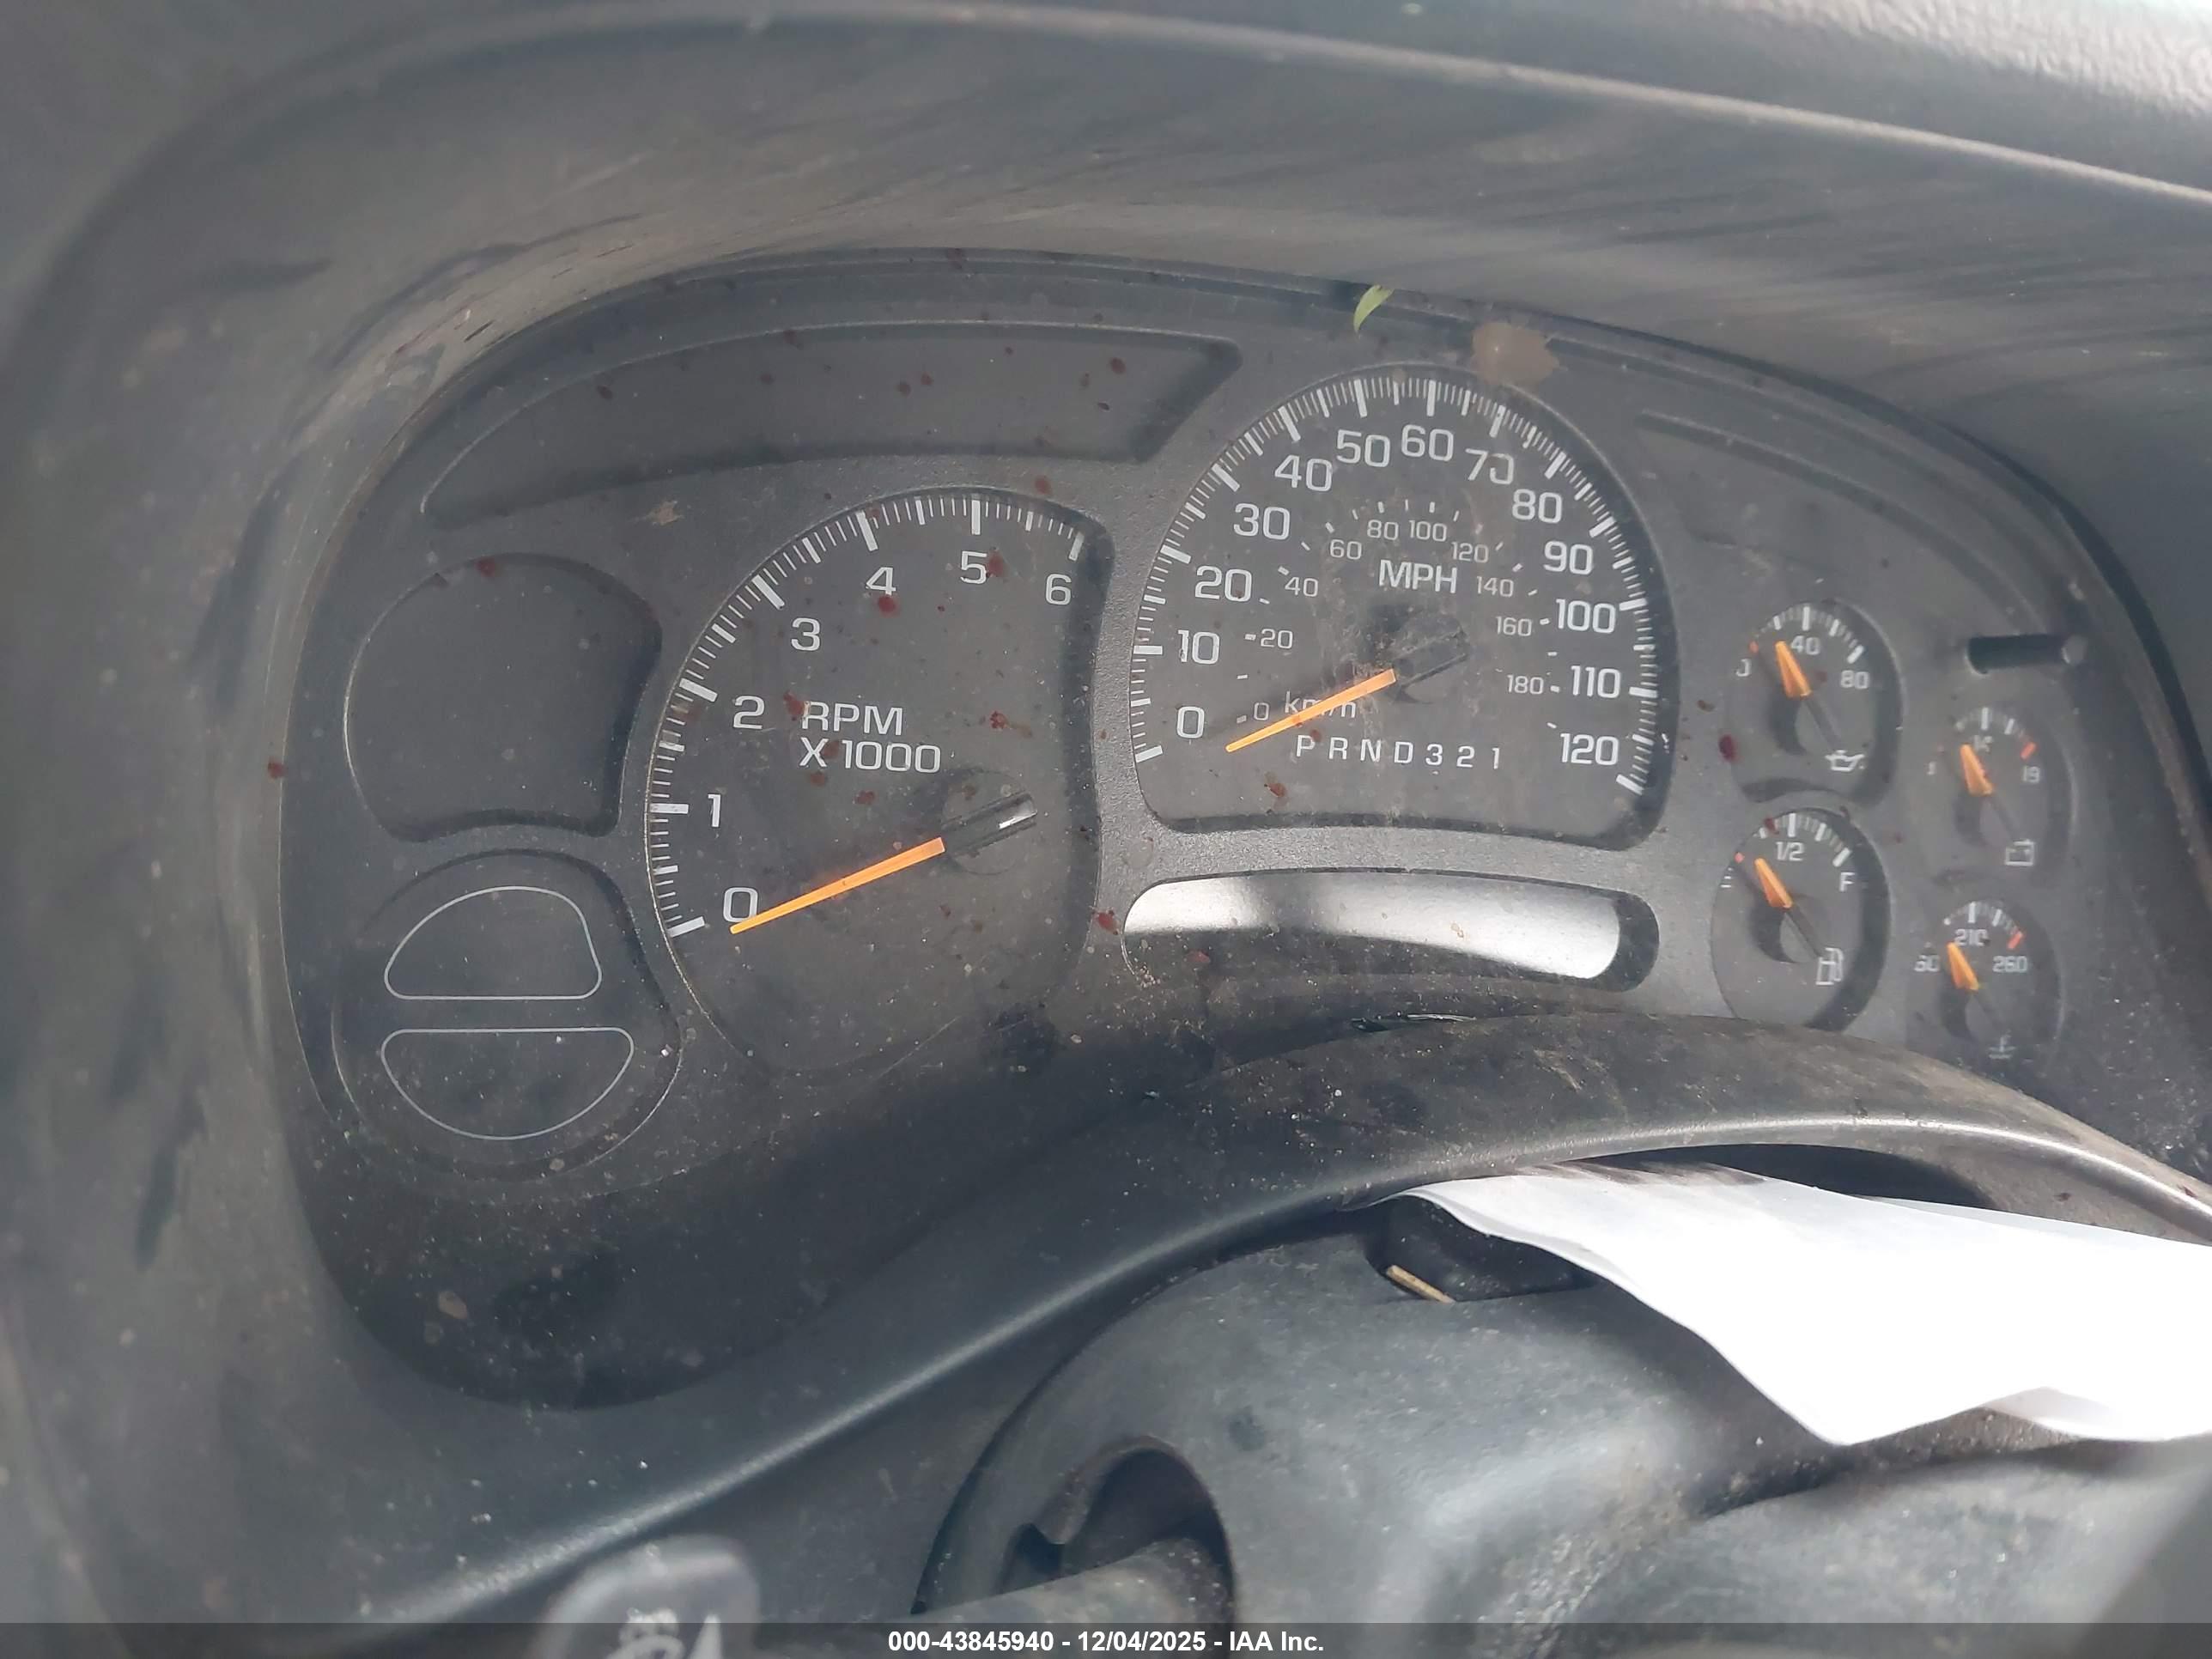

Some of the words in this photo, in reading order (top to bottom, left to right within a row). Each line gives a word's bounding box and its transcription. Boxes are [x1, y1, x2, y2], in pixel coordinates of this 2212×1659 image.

[1336, 429, 1391, 468] 50
[1401, 424, 1454, 462] 60
[1274, 454, 1333, 492] 40
[1466, 448, 1515, 485] 70
[1233, 502, 1291, 540] 30
[1512, 489, 1563, 524] 80
[1366, 519, 1399, 541] 80
[1409, 520, 1448, 542] 100
[1329, 538, 1362, 561] 60
[1452, 541, 1489, 563] 120
[1544, 540, 1593, 575] 90
[866, 567, 896, 596] 4
[960, 550, 988, 585] 5
[1194, 565, 1252, 602] 20
[1378, 559, 1458, 594] MPH
[1045, 574, 1072, 605] 6
[1285, 576, 1319, 598] 40
[1477, 575, 1515, 598] 140
[1497, 616, 1533, 637] 160
[1556, 599, 1616, 634] 100
[791, 617, 820, 651] 3
[1178, 629, 1220, 665] 10
[1260, 628, 1293, 649] 20
[1790, 635, 1820, 655] 40
[1507, 674, 1545, 695] 180
[1571, 665, 1621, 698] 110
[1840, 670, 1869, 690] 80
[733, 696, 765, 730] 2
[802, 702, 902, 736] RPM
[1176, 706, 1205, 738] 0
[1254, 702, 1269, 721] 0
[1296, 734, 1316, 757] P
[1328, 737, 1348, 760] R
[1360, 738, 1382, 762] N
[1394, 741, 1413, 764] D
[1425, 744, 1443, 766] 3
[1456, 745, 1475, 768] 2
[1492, 747, 1500, 769] 1
[1560, 732, 1620, 766] 120
[708, 793, 721, 828] 1
[1776, 841, 1803, 862] 1/2
[1839, 872, 1854, 891] F
[722, 887, 758, 923] 0
[1992, 955, 2027, 973] 260
